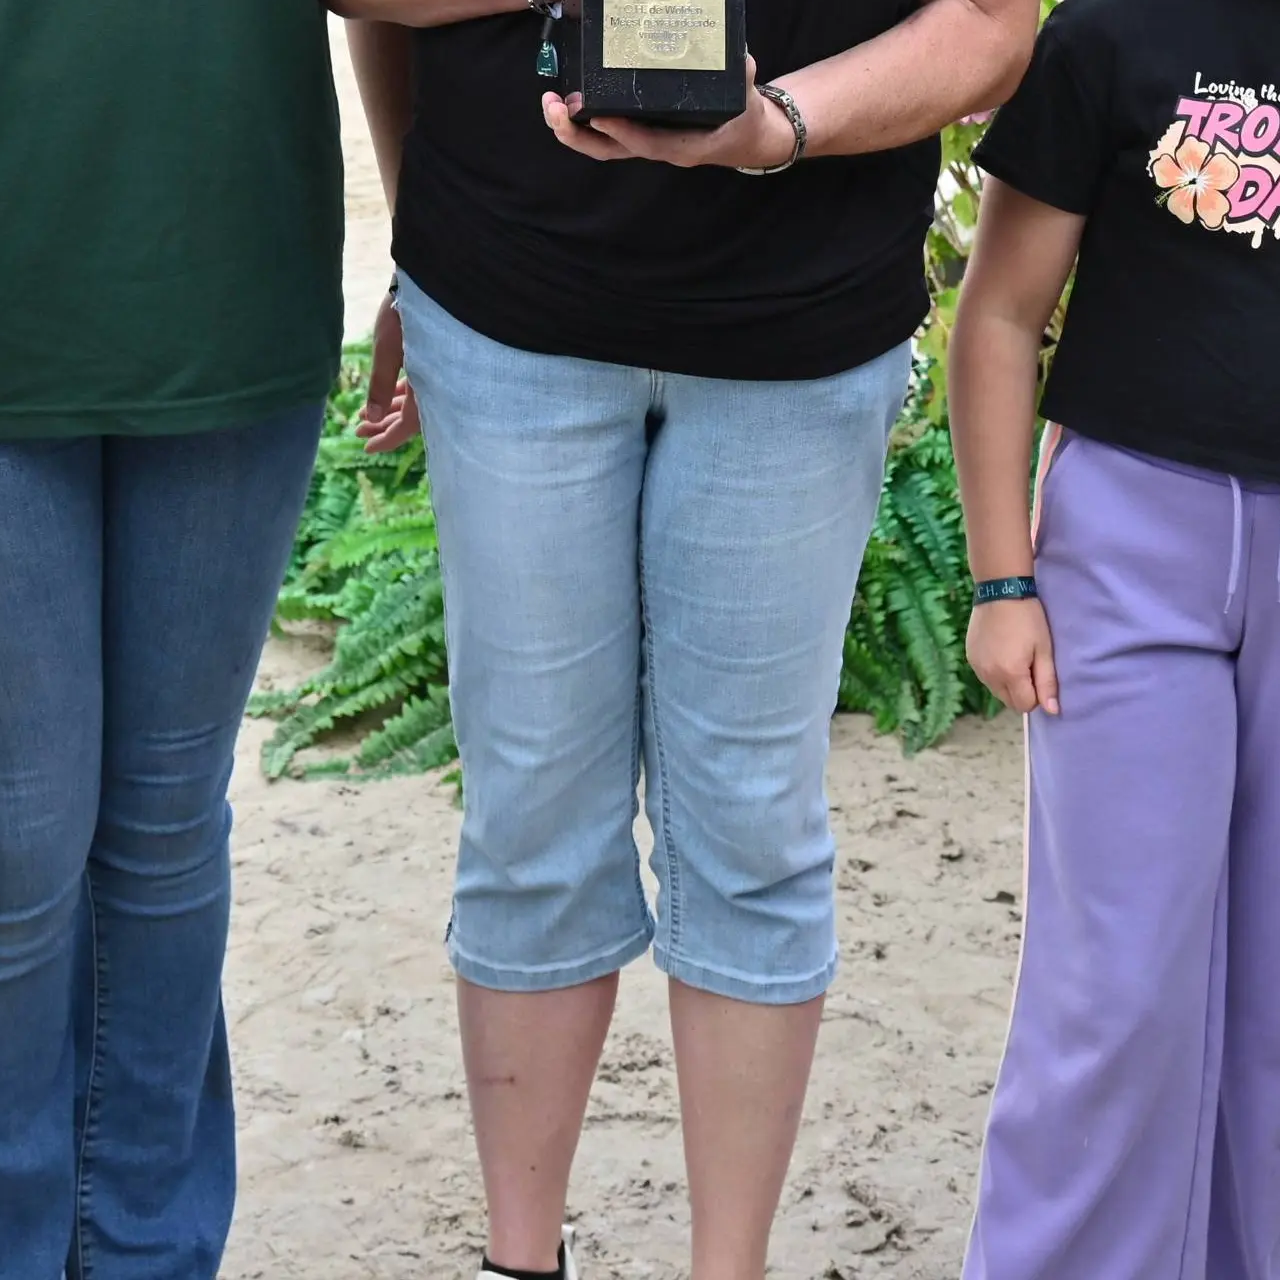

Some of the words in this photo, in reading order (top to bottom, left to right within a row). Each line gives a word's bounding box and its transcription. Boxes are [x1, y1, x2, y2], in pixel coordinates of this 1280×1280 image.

[649, 4, 663, 15] de
[665, 4, 703, 15] Wolden
[1194, 71, 1259, 107] Loving
[1001, 581, 1015, 595] de
